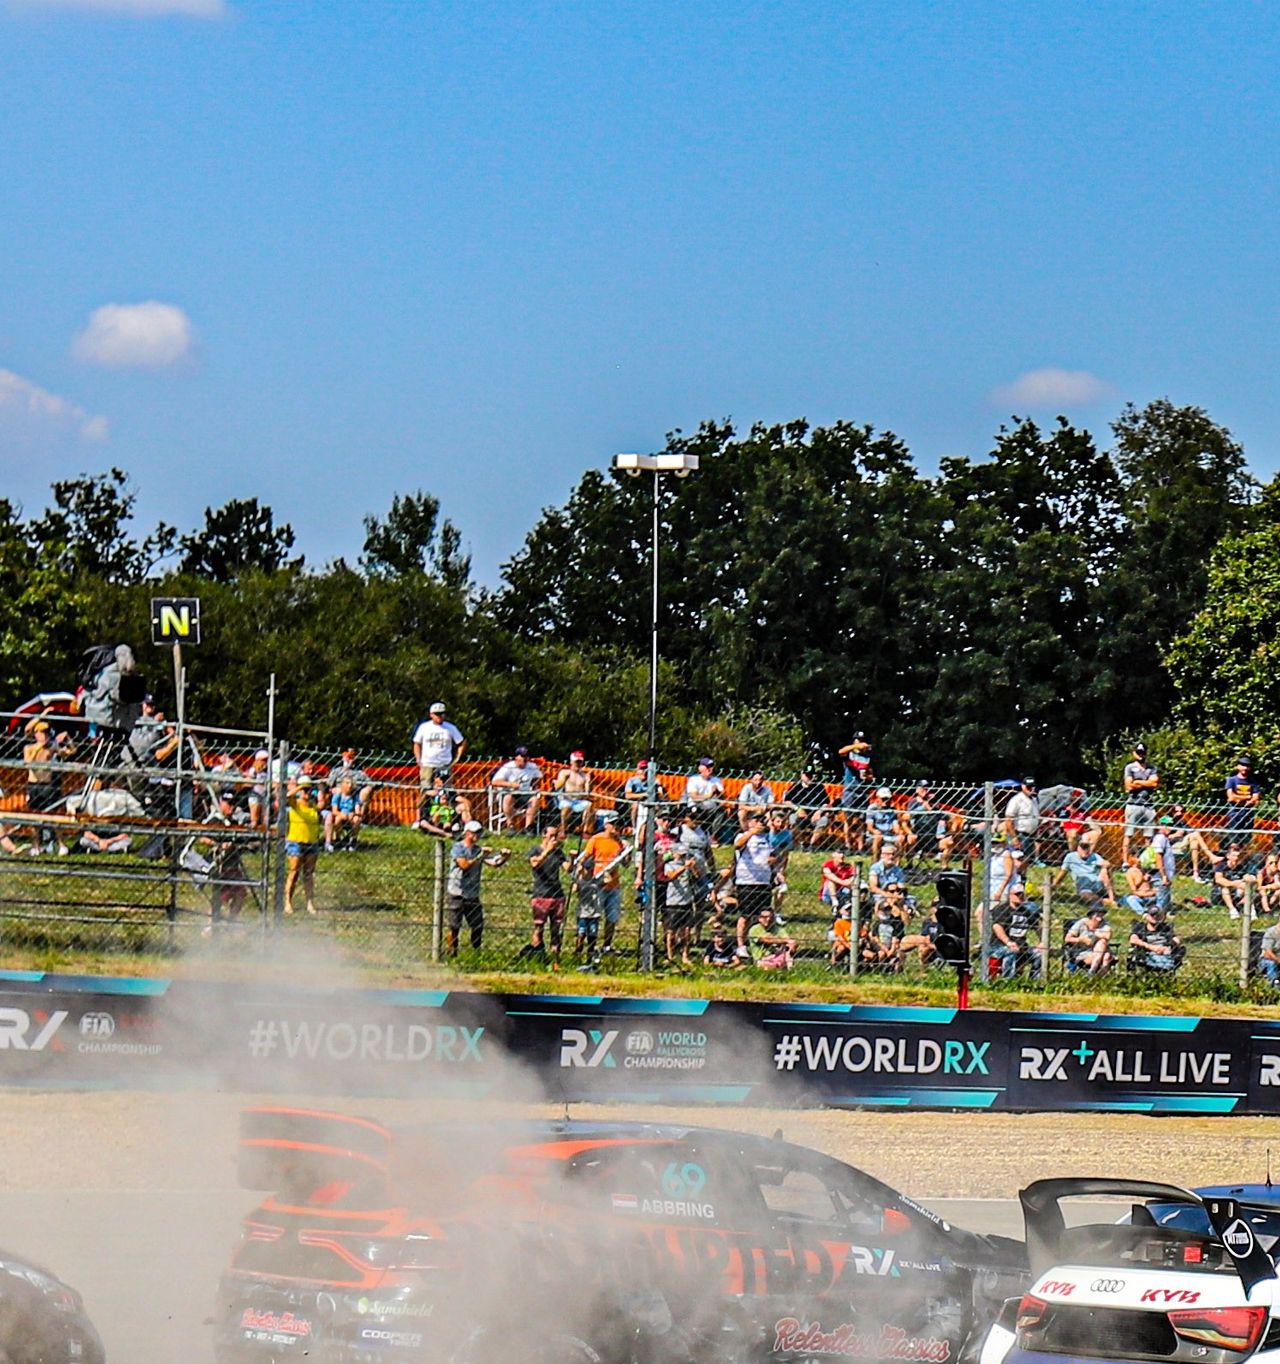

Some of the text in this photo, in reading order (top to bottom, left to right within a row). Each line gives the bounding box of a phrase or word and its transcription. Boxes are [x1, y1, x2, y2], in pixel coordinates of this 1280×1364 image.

[161, 606, 189, 636] N
[78, 1015, 113, 1036] FIA
[78, 1043, 162, 1055] CHAMPIONSHIP
[248, 1020, 485, 1063] #WORLDRX
[560, 1029, 619, 1068] RX
[626, 1032, 653, 1054] FIA
[658, 1032, 707, 1047] WORLD
[624, 1056, 706, 1069] CHAMPIONSHIP
[774, 1035, 991, 1075] #WORLDRX
[1160, 1051, 1231, 1084] LIVE
[662, 1162, 706, 1198] 69
[641, 1200, 715, 1218] ABBRING
[851, 1246, 901, 1277] RX
[1140, 1289, 1201, 1304] KYB
